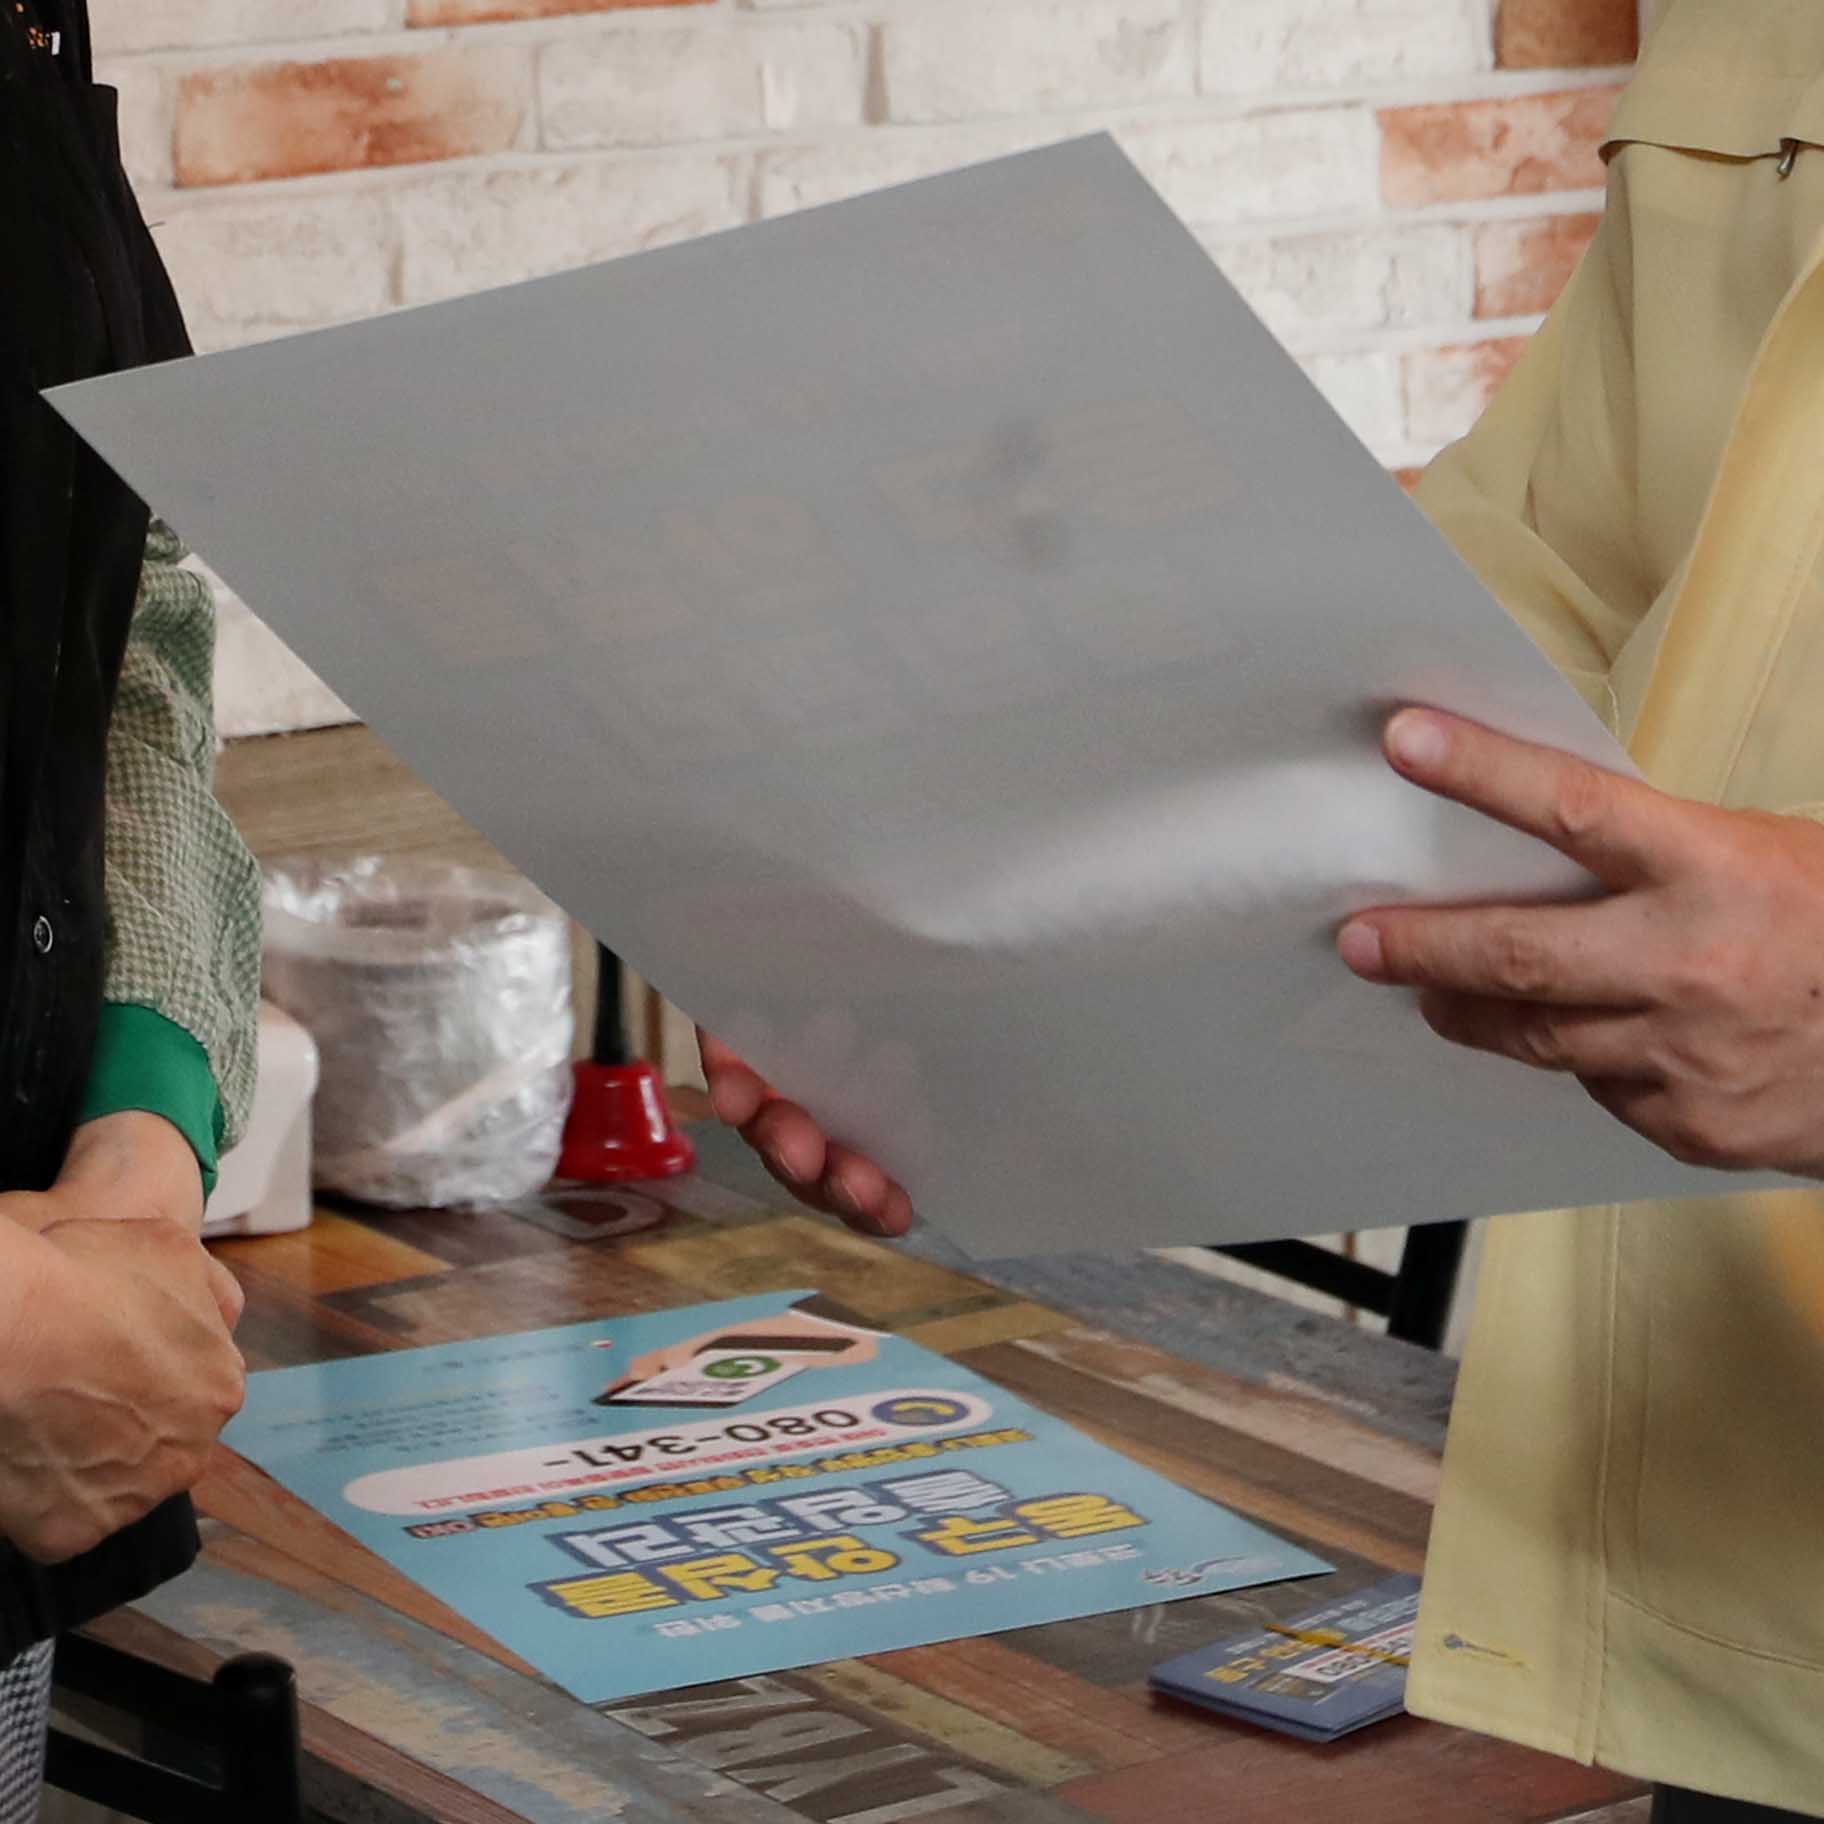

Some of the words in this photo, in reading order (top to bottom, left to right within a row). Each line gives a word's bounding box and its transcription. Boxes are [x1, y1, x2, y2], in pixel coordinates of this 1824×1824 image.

[552, 1466, 1021, 1571] 출입관리
[891, 1489, 1156, 1559] 동구
[539, 1531, 902, 1620] 안심콜
